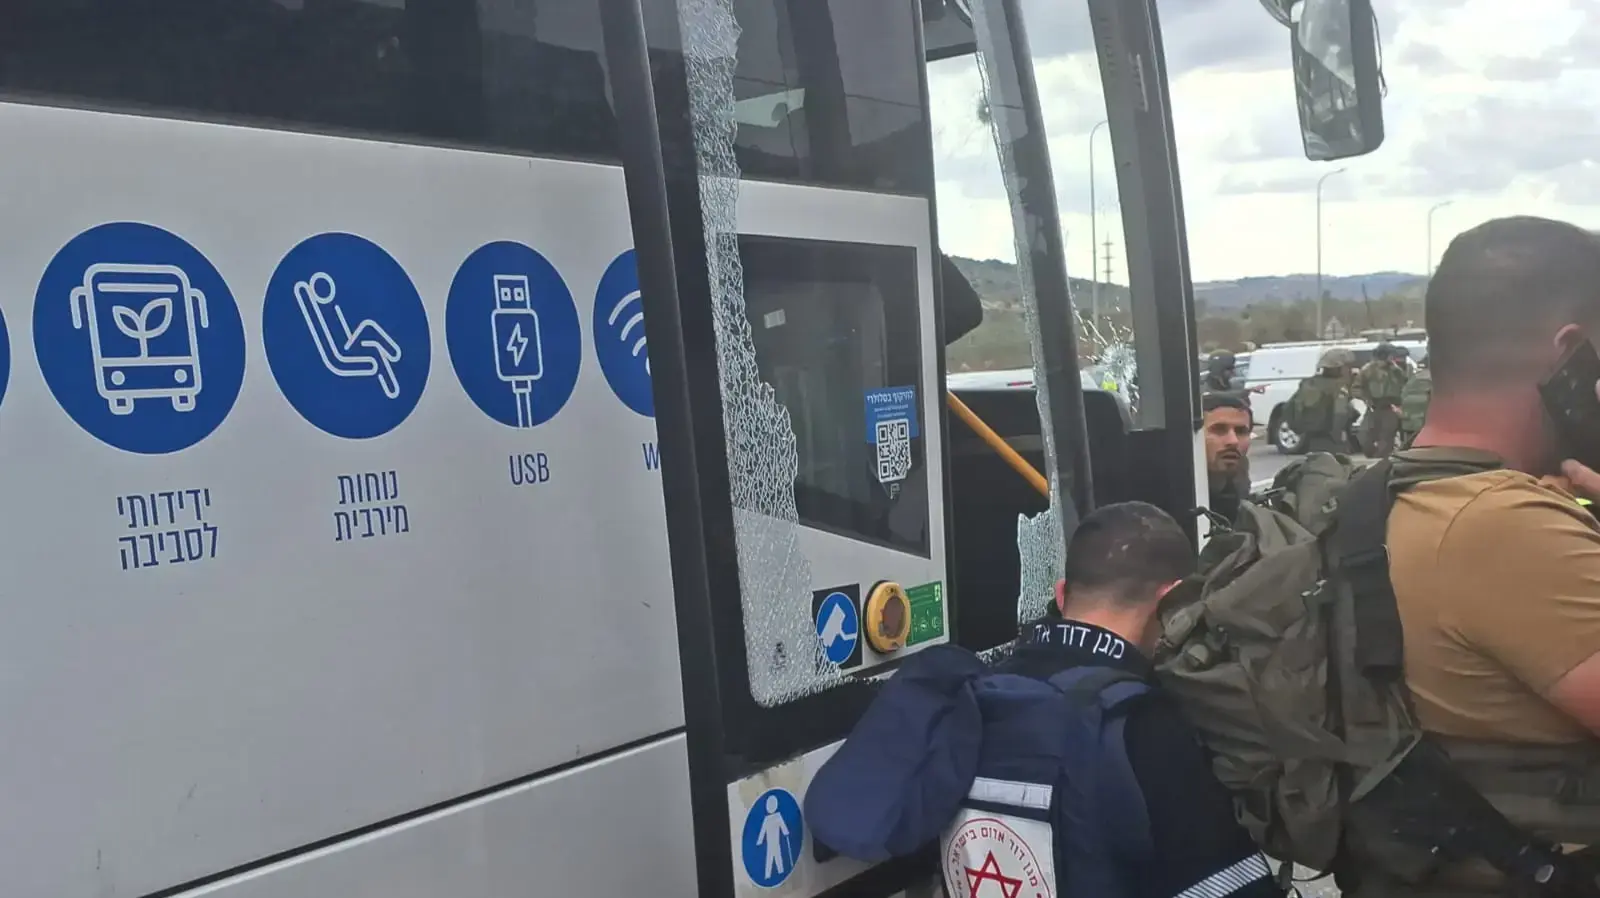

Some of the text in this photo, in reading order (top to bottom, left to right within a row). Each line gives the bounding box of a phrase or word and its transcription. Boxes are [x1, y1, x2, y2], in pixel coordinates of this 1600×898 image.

[509, 452, 550, 486] USB
[337, 470, 398, 505] נוחות
[117, 488, 210, 528] ידידותי
[334, 505, 409, 541] מירבית
[118, 522, 218, 571] לסביבה
[1034, 623, 1125, 659] מגן דוד אד
[980, 826, 1006, 843] אדום
[1009, 838, 1025, 861] דוד
[1022, 861, 1039, 887] מגן
